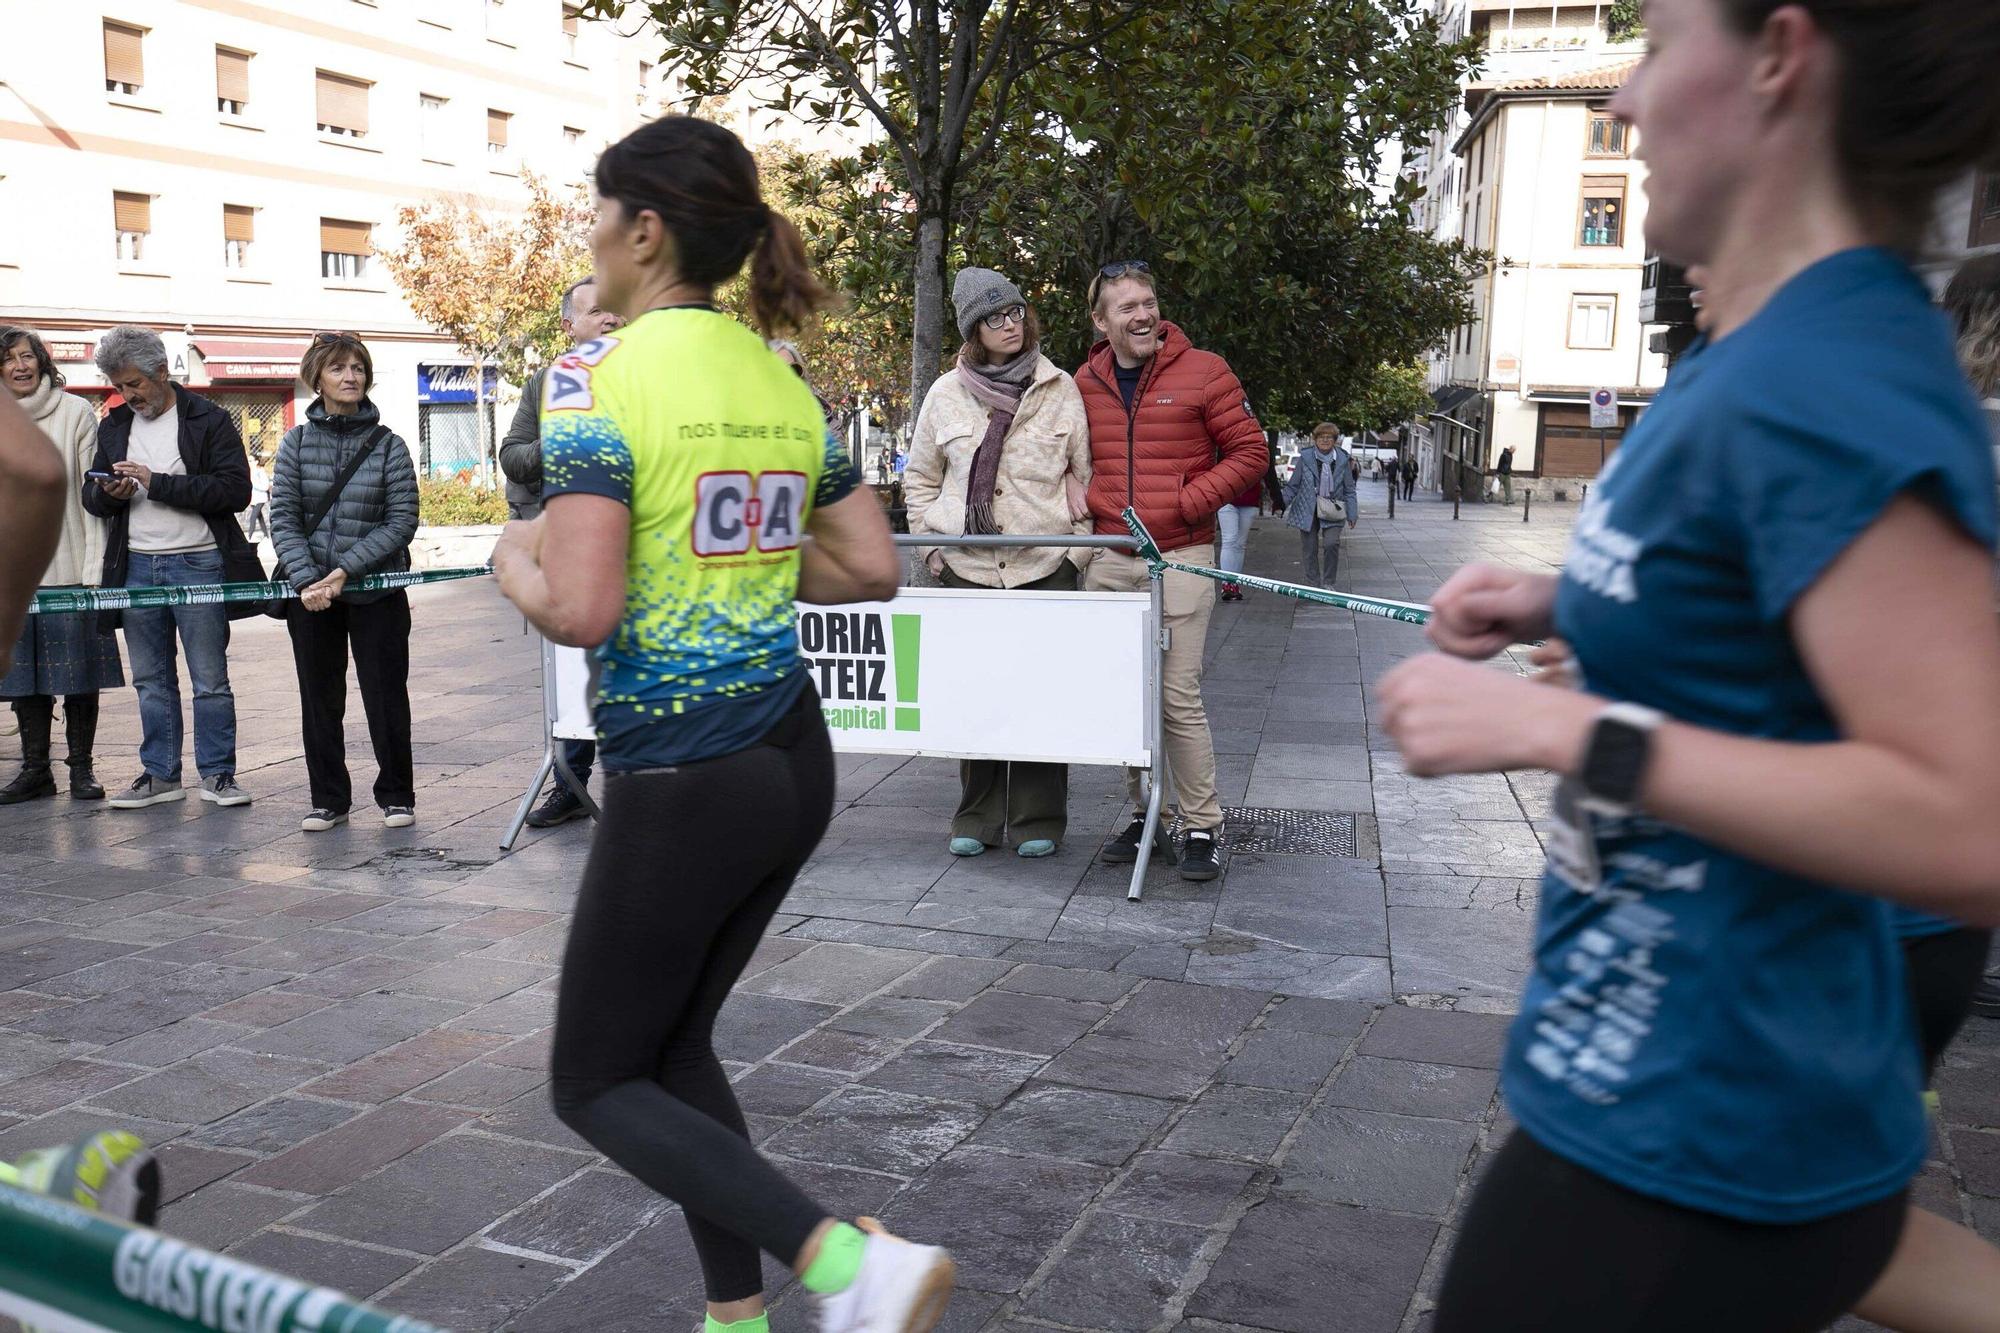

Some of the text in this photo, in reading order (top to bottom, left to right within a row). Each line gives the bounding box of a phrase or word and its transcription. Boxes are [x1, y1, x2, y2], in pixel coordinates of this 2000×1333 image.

[51, 343, 86, 351] TABACOS
[226, 365, 253, 375] CAVA
[678, 422, 717, 440] nos
[797, 611, 886, 655] ORIA
